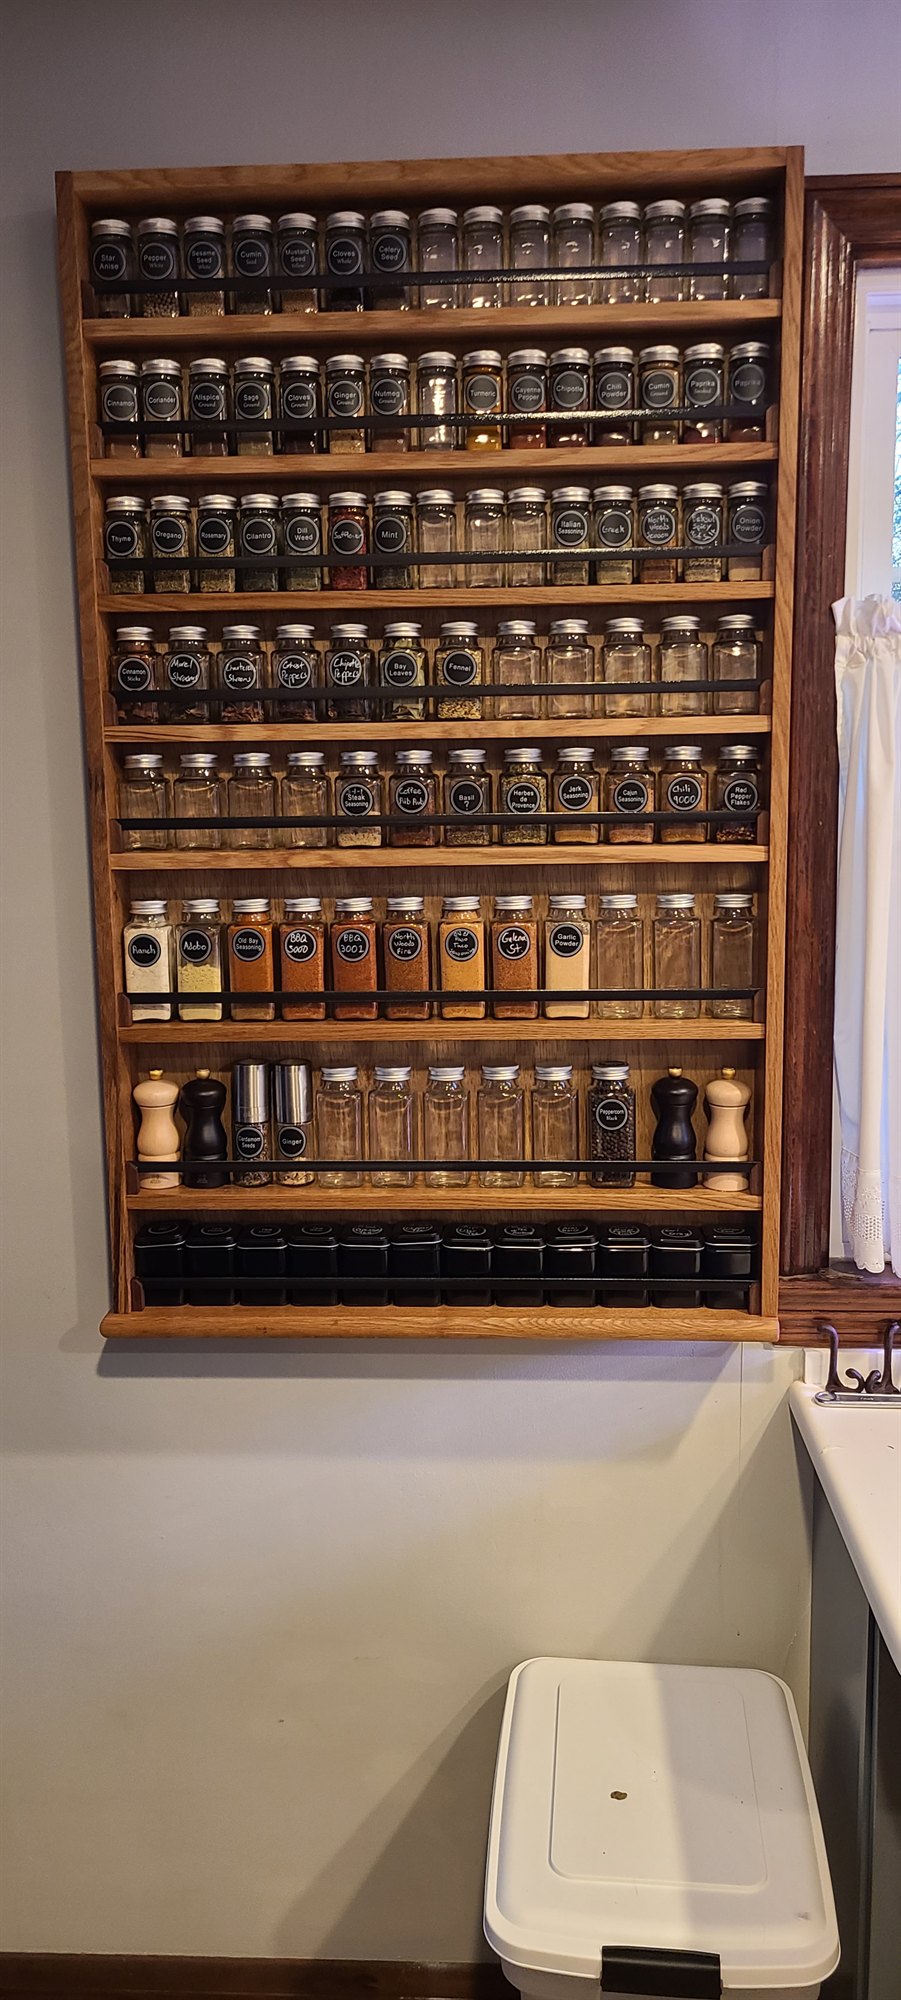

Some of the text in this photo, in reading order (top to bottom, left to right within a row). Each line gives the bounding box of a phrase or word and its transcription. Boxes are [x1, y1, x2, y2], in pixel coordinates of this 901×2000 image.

[378, 246, 401, 255] Celery
[143, 254, 166, 262] Pepper
[606, 383, 622, 391] Chili
[690, 380, 715, 388] Paprika
[735, 379, 761, 388] Paprika
[516, 386, 541, 394] Cayenne
[556, 385, 583, 393] Chipotle
[194, 393, 220, 401] Allspice
[243, 393, 259, 402] Sage
[334, 391, 357, 400] Ginger
[375, 390, 400, 399] Nutmeg
[517, 393, 540, 401] Pepper
[601, 391, 627, 399] Powder
[107, 399, 134, 407] Cinnamon
[149, 396, 176, 404] Coriander
[602, 525, 625, 534] Greek
[156, 530, 182, 540] Oregano
[201, 532, 227, 540] Rosemary
[246, 533, 272, 541] Cilantro
[381, 531, 398, 539] Mint
[111, 535, 131, 544] Thyme
[449, 663, 471, 671] Fennel
[399, 787, 422, 795] Coffee
[563, 792, 589, 800] Seasoning
[673, 795, 696, 804] 9000
[463, 800, 470, 810] ?
[290, 933, 308, 943] BBQ
[343, 933, 362, 942] BBQ
[183, 940, 207, 951] Adobo
[236, 943, 262, 951] Seasoning
[554, 939, 579, 947] Powder
[132, 944, 156, 954] Ranch
[287, 945, 309, 954] 3000
[340, 944, 365, 953] 3001
[282, 1138, 302, 1146] Ginger
